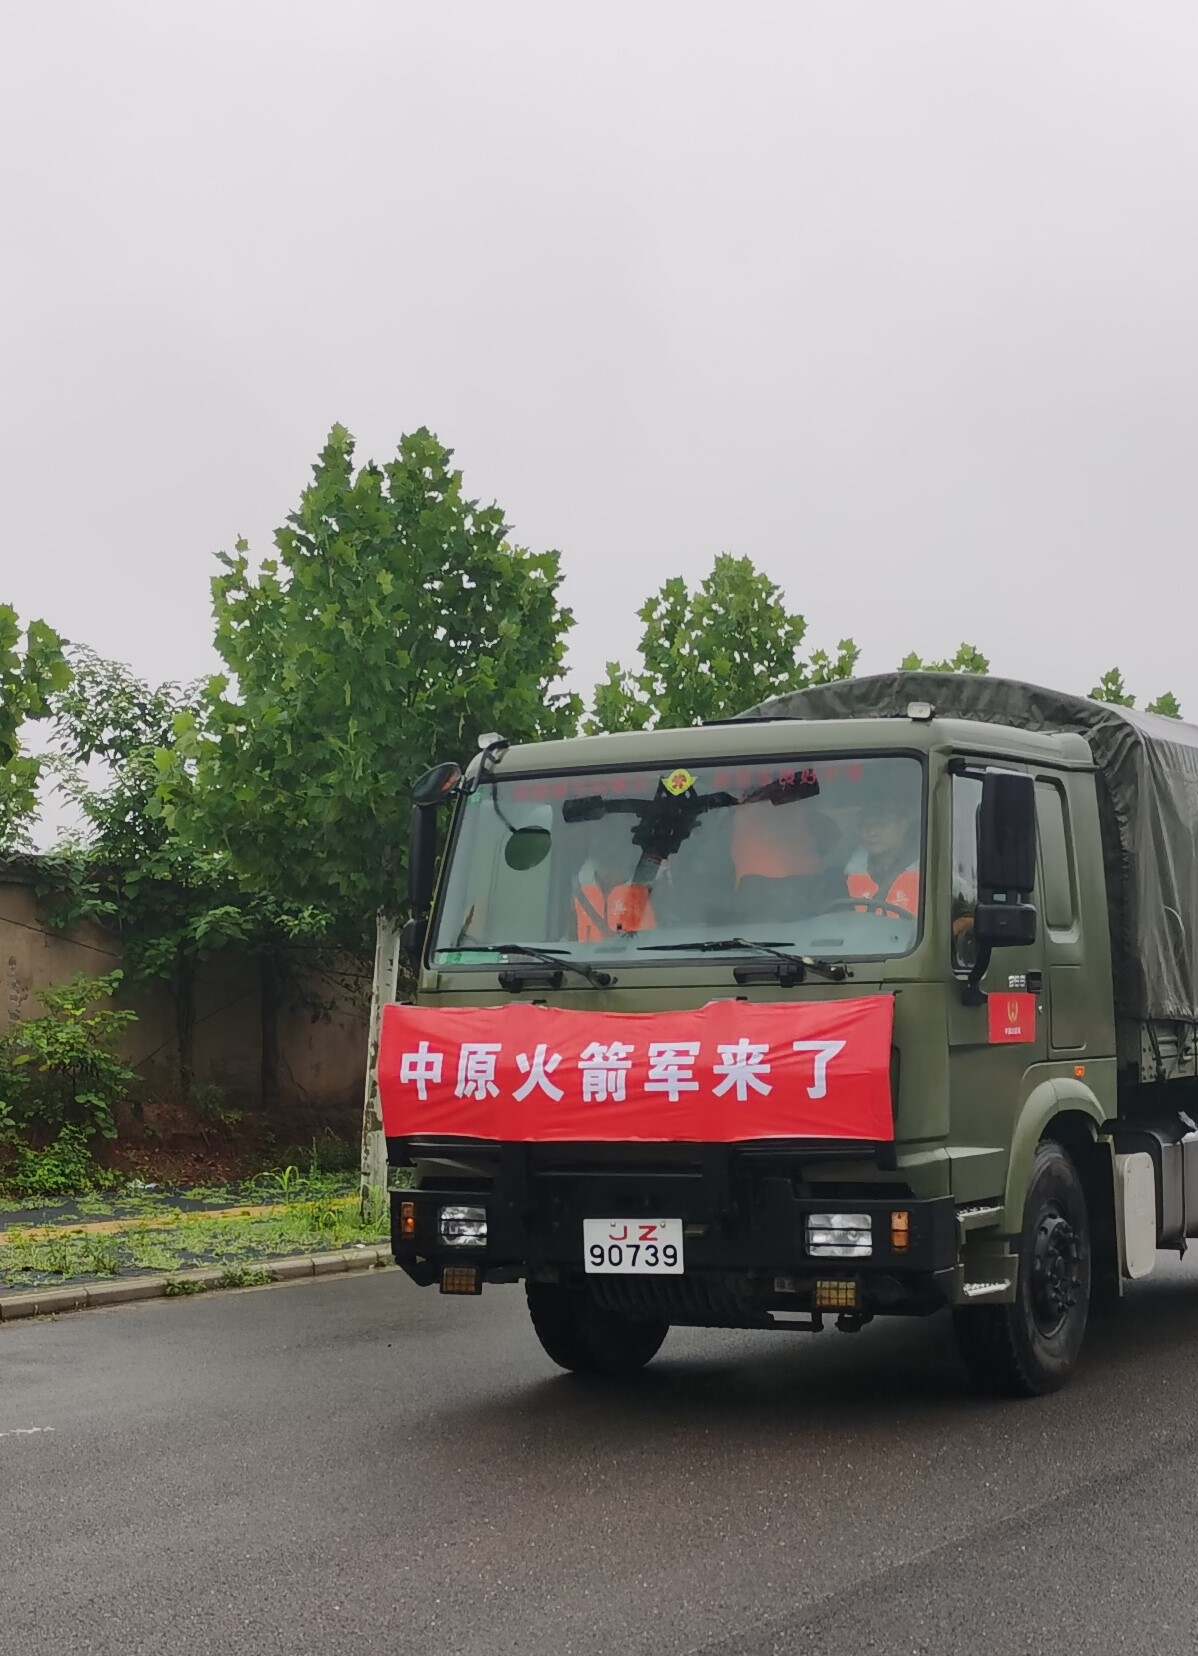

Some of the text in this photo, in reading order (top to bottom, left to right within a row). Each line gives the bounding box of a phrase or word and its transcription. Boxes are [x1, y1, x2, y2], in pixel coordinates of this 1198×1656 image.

[399, 1038, 847, 1102] 中原火箭军来了
[609, 1225, 658, 1241] JZ
[590, 1244, 678, 1268] 90739
